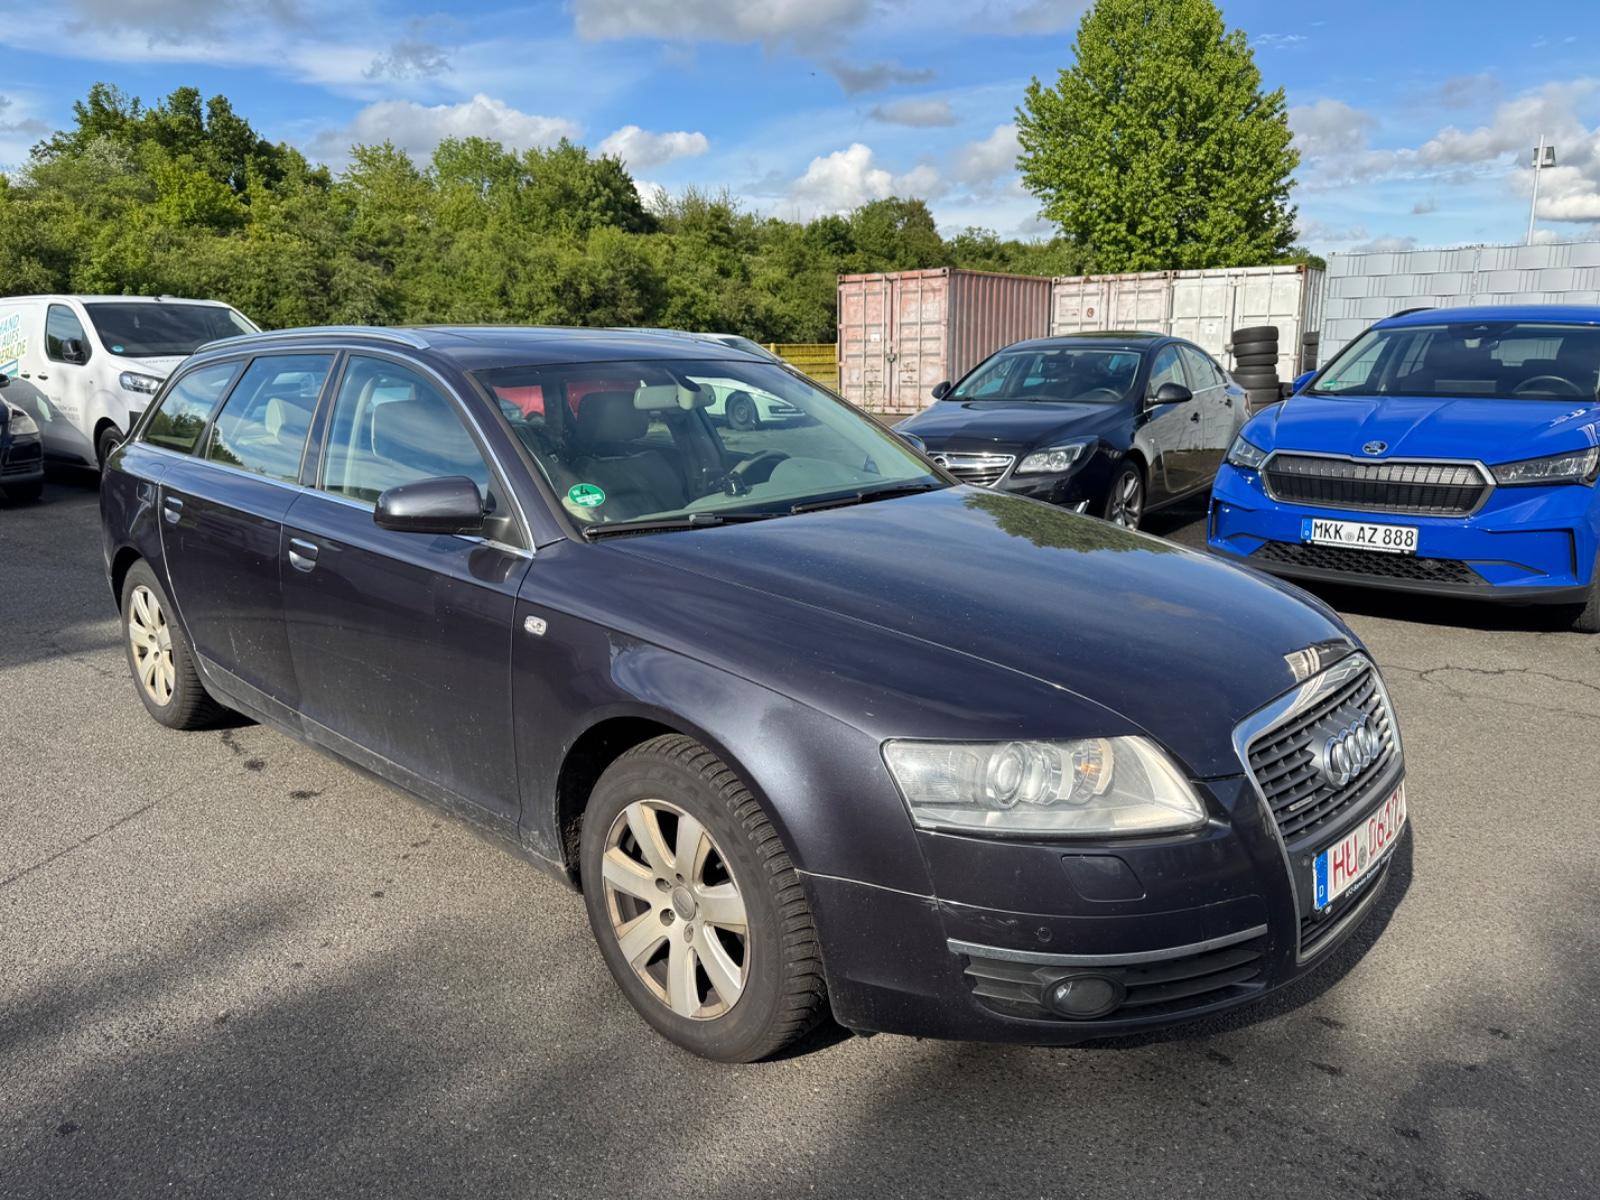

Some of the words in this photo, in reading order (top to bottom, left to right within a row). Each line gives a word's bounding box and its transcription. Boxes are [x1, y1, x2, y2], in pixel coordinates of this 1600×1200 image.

[1313, 521, 1344, 540] MKK
[1356, 526, 1378, 544] AZ
[1382, 528, 1414, 547] 888
[1333, 834, 1358, 889] HU
